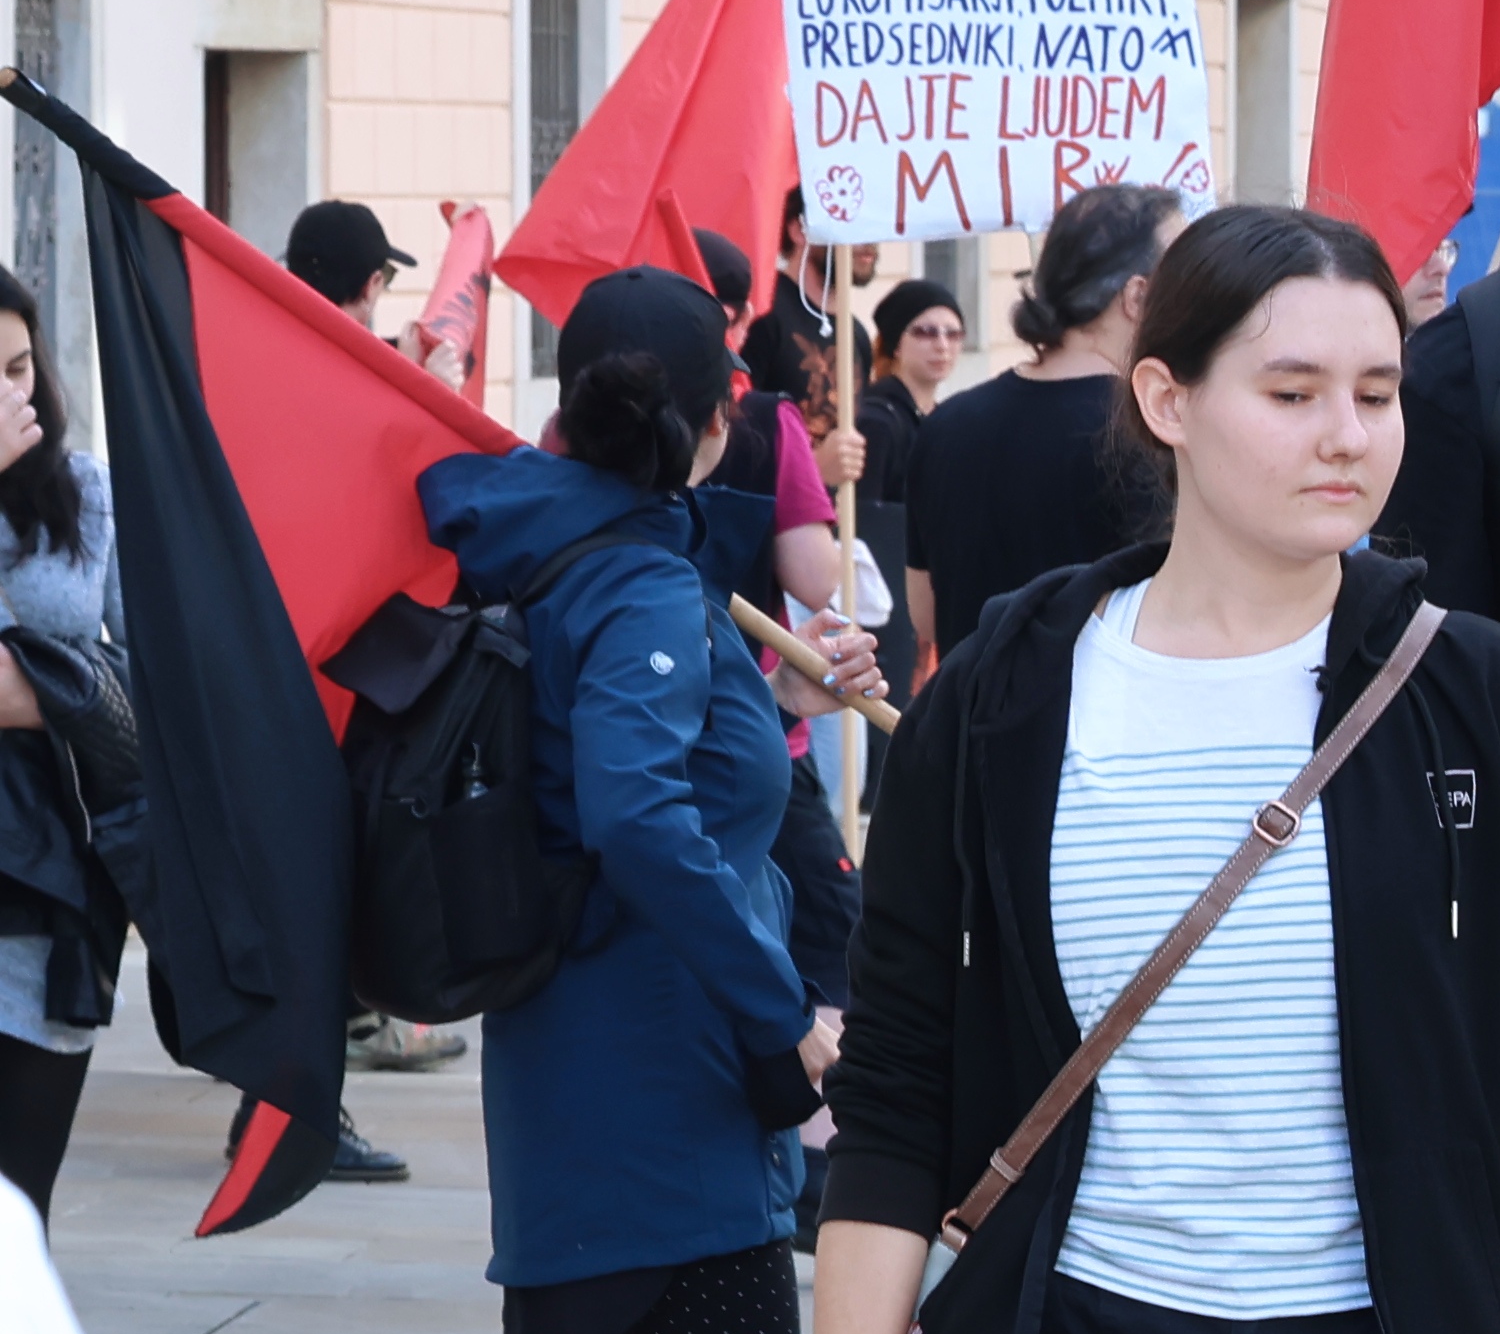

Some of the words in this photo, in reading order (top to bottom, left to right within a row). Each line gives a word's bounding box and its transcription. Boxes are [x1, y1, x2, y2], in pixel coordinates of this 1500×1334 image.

[1034, 23, 1144, 73] NATO
[815, 73, 973, 148] DAJTE
[998, 74, 1166, 142] LJUDEM
